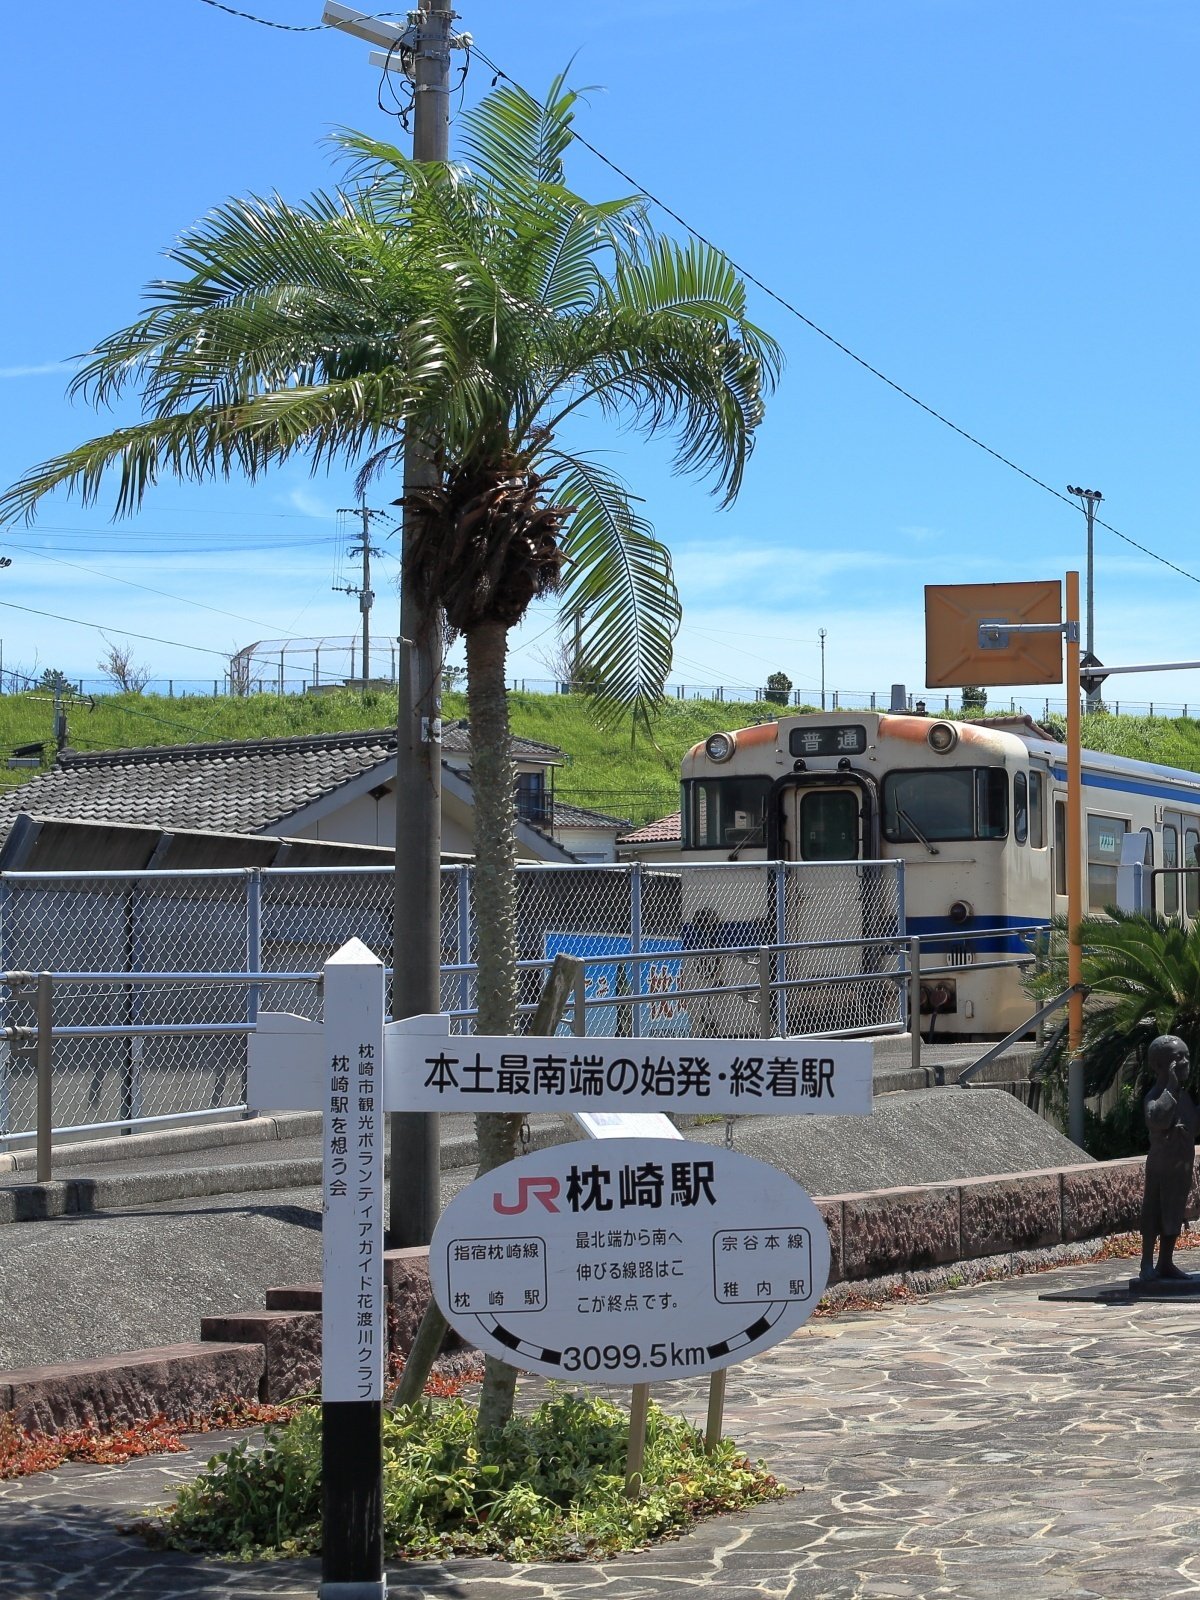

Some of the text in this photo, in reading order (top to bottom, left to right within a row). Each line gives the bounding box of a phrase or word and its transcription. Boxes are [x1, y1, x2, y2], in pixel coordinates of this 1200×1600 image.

[801, 729, 859, 752] 普通
[424, 1052, 835, 1098] 本土最南端の始発・終着駅
[329, 1055, 350, 1197] 枕崎駅を想う会
[493, 1160, 717, 1216] JR 枕崎駅
[357, 1043, 375, 1399] 枕崎市観光ボランティアガイド花渡川クラブ
[576, 1227, 683, 1249] 最北端から南へ
[722, 1234, 804, 1251] 宗谷本線
[454, 1243, 539, 1261] 指宿枕崎線
[576, 1259, 684, 1282] 伸びる線路はこ
[577, 1292, 679, 1314] こが終点です。
